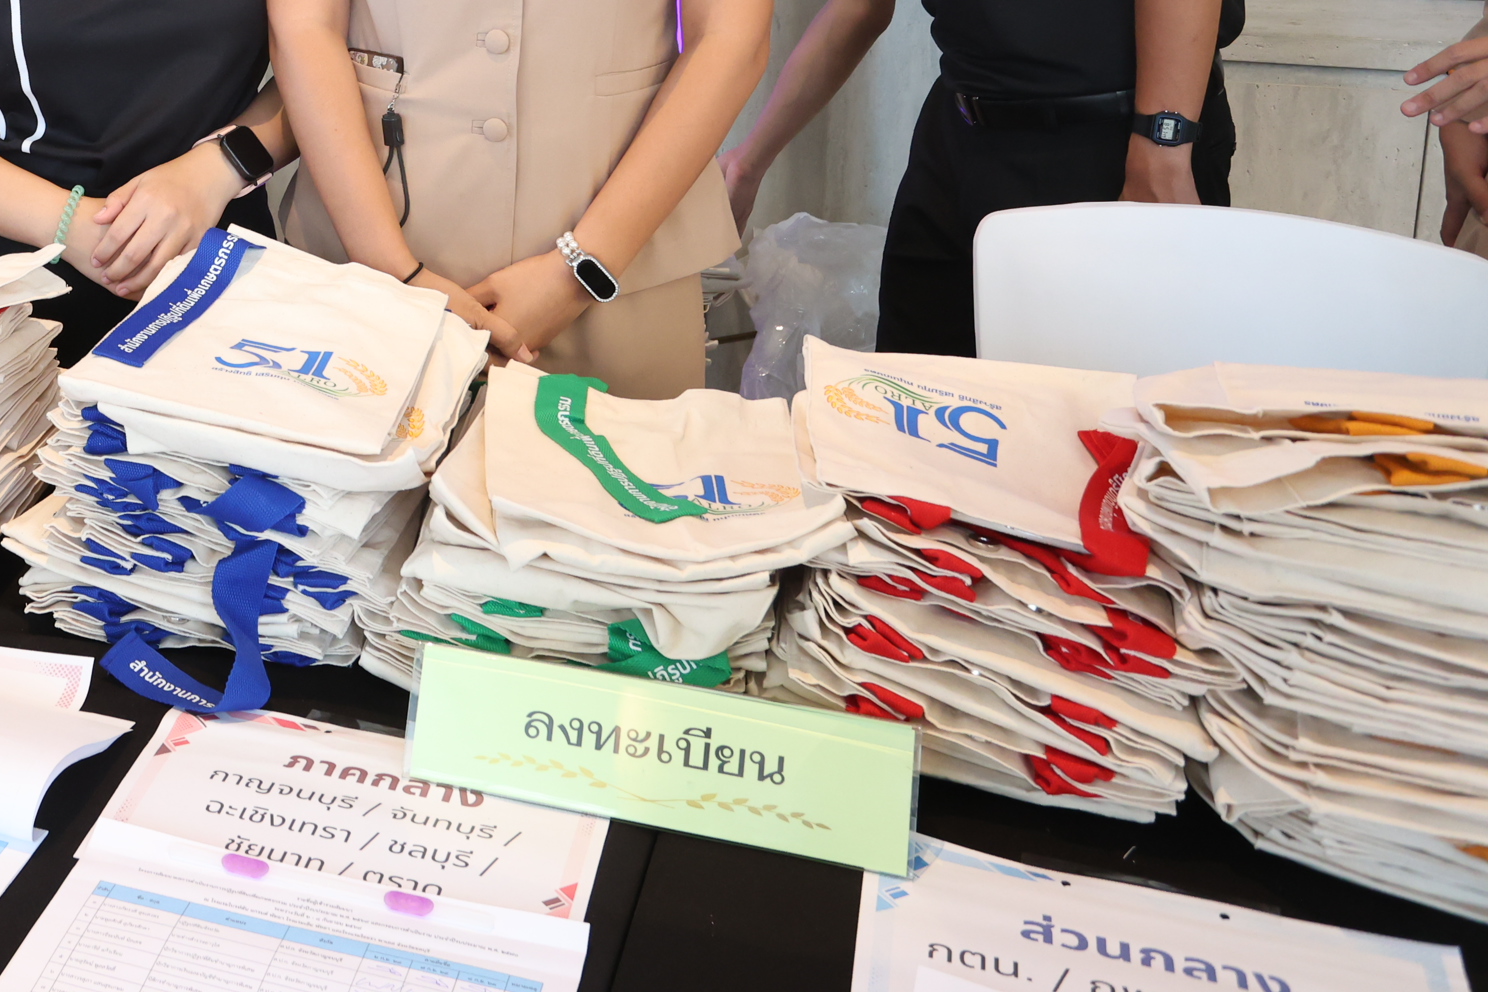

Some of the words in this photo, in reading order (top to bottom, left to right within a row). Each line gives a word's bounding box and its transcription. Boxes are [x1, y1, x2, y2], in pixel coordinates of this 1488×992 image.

[118, 232, 242, 354] สำนักงานการปฏิรูปที่ดินเพื่อเกษตรกรร
[214, 338, 335, 381] 51
[874, 384, 934, 412] ALRO
[883, 395, 1008, 468] 51
[283, 754, 485, 808] ภาคกลาง
[524, 710, 786, 786] ลงทะเบียน
[205, 799, 352, 843] ฉะเชิงเทรา
[388, 838, 474, 870] ชลบุรี
[209, 769, 359, 811] กาญจนบุรี
[390, 806, 498, 840] จันทบุรี
[224, 835, 325, 872] ชัยนาท
[927, 942, 1033, 982] กตน.
[1020, 914, 1292, 992] ส่วนกลาง
